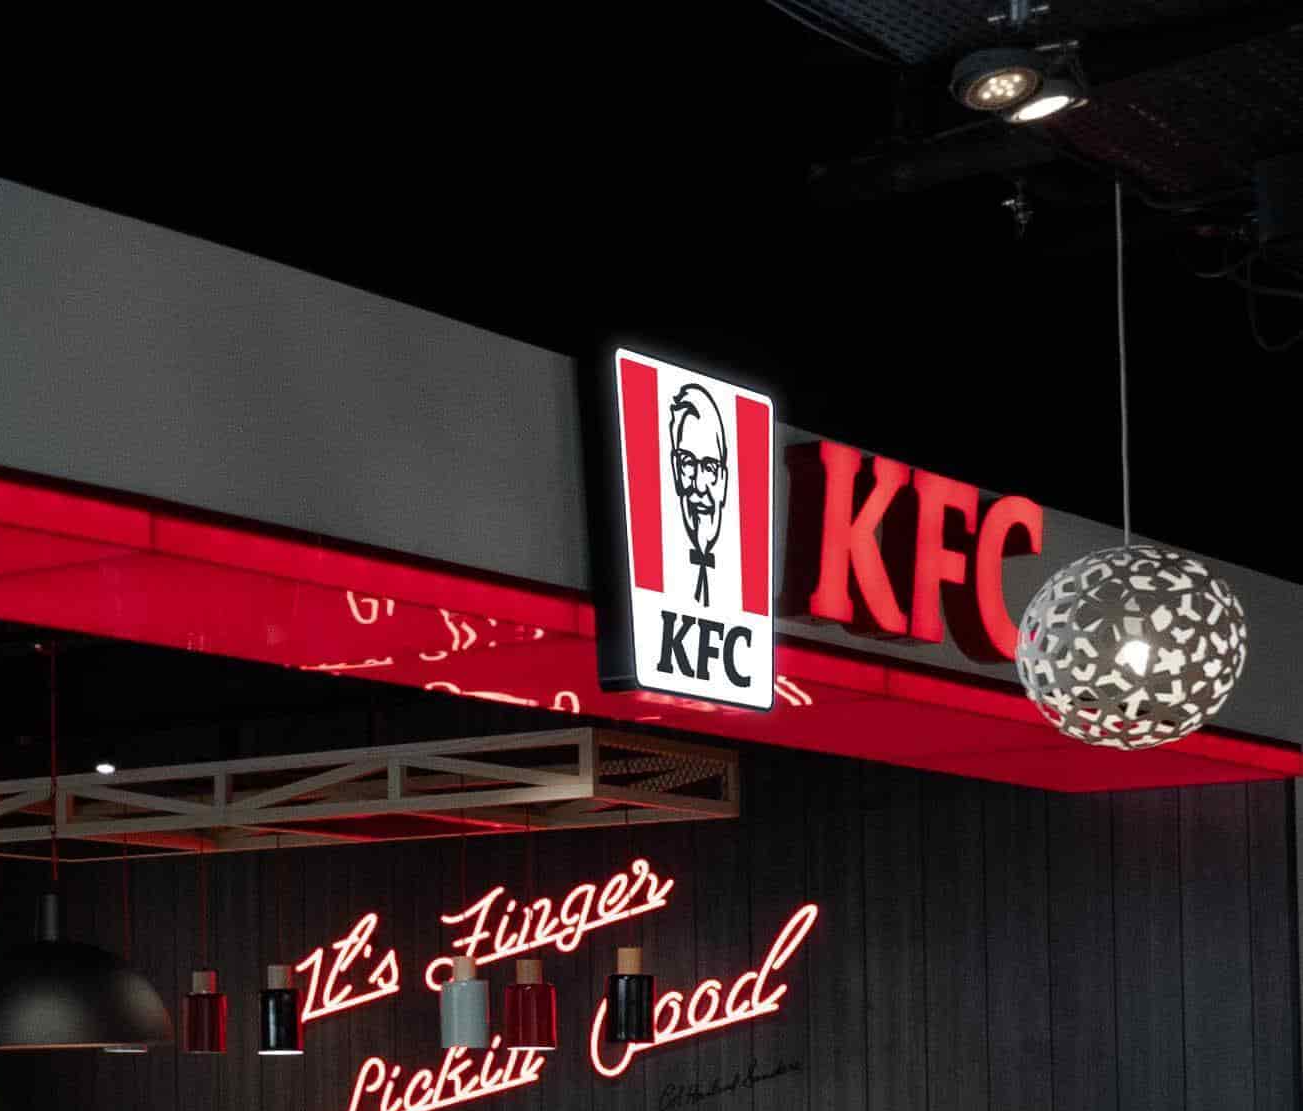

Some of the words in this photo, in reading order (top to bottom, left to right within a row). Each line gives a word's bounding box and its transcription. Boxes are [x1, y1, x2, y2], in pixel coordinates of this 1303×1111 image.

[810, 440, 1044, 663] KFC
[657, 610, 752, 688] KFC
[296, 913, 401, 1023] It's
[425, 859, 675, 992] Finger
